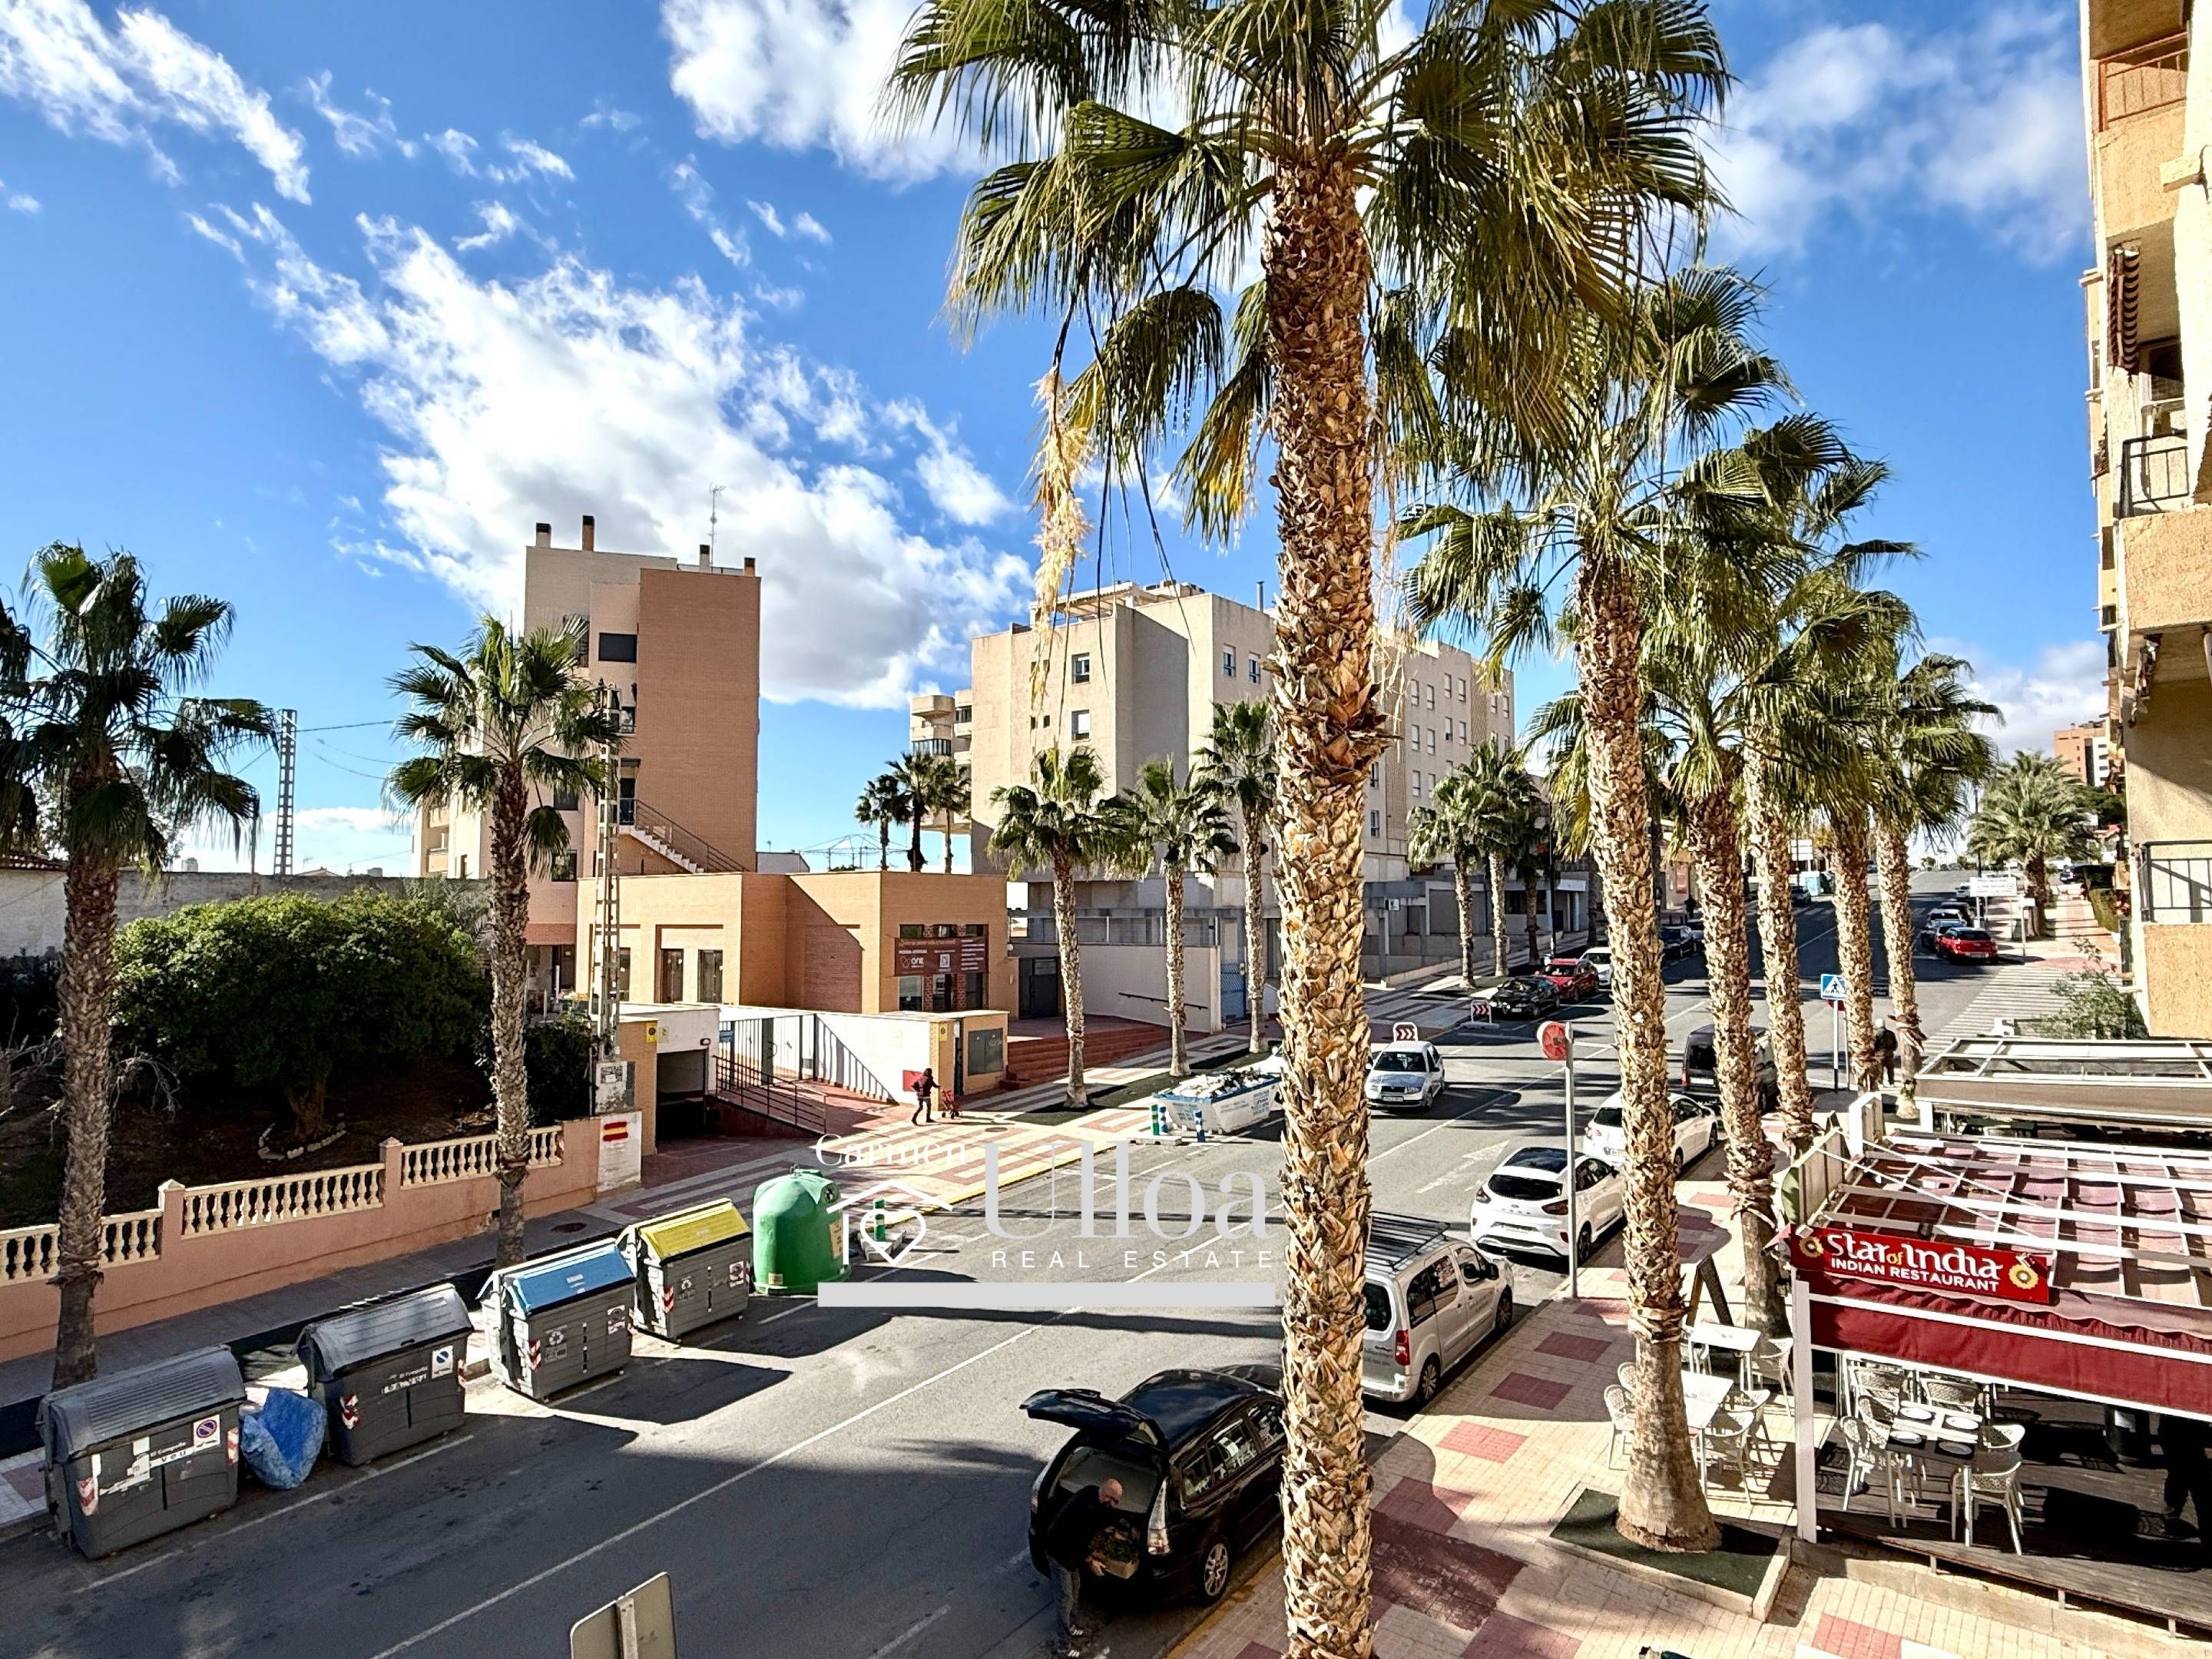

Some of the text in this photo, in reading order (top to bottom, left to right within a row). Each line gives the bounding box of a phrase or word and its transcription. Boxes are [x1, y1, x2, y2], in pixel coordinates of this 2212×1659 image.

[1827, 1233, 2003, 1280] Star of India
[1831, 1258, 1999, 1293] INDIAN RESTAURANT
